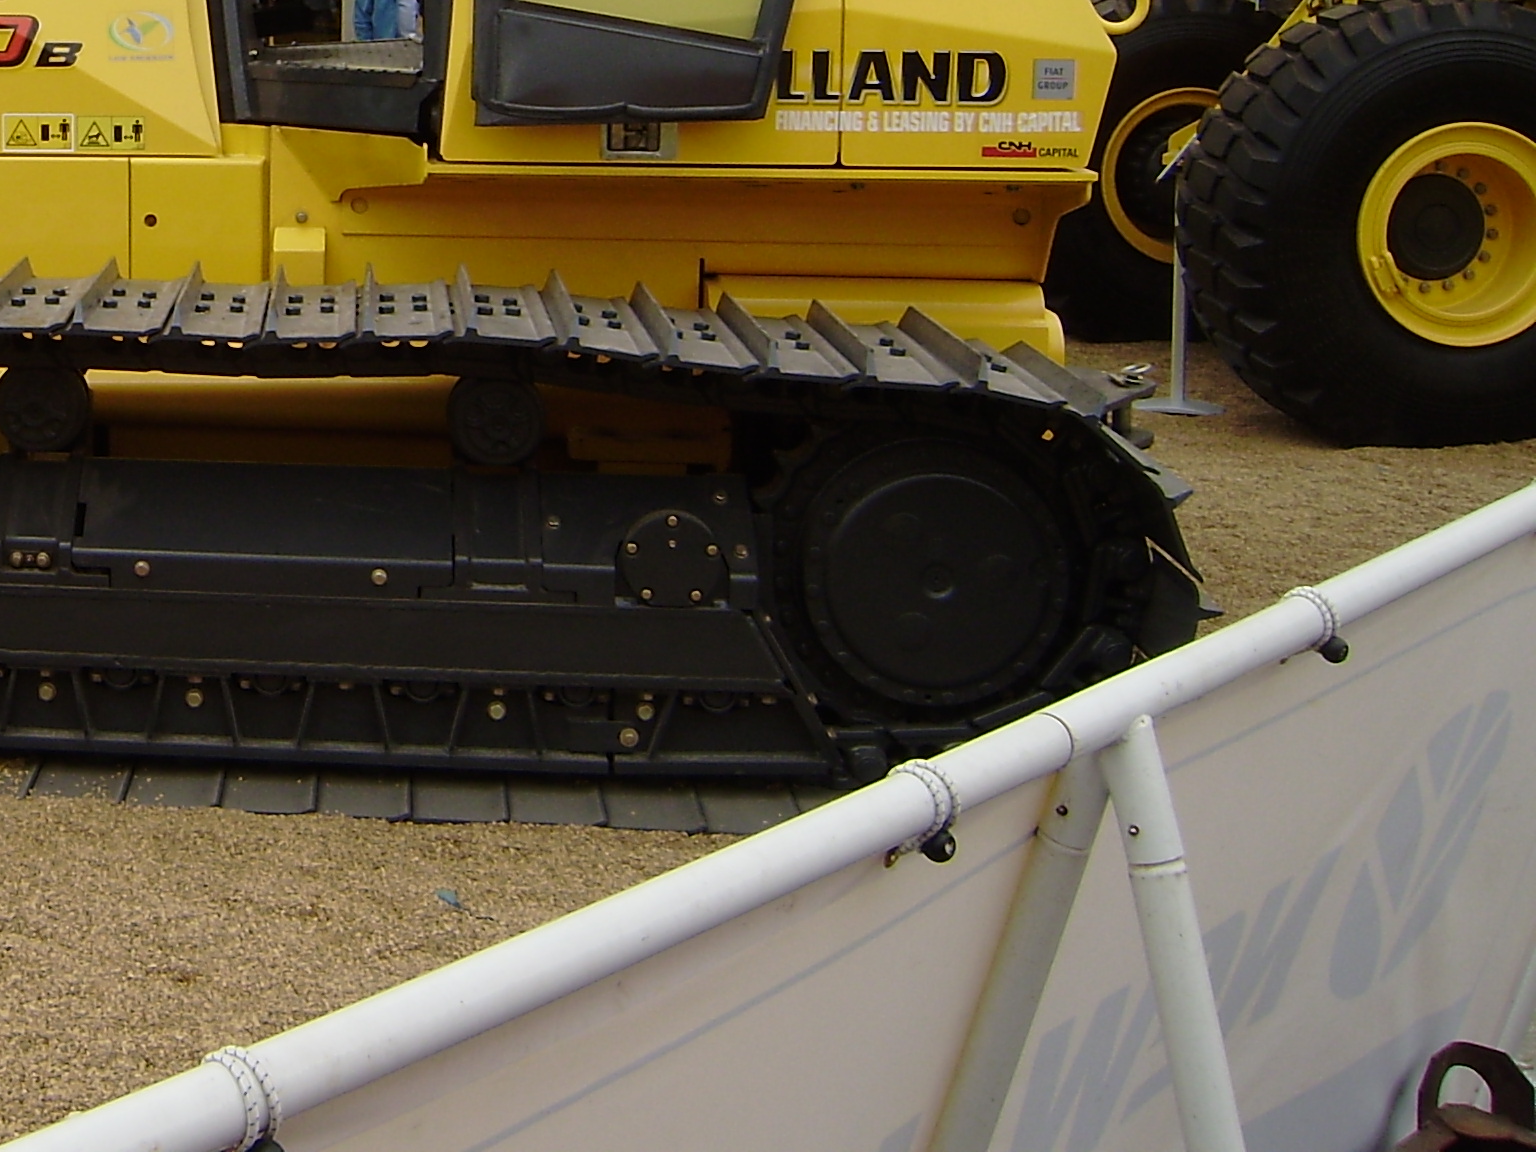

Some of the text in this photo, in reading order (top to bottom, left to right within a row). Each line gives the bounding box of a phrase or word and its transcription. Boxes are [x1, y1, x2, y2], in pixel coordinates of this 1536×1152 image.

[1044, 67, 1063, 76] FIAT
[1037, 81, 1069, 90] GROUP
[775, 110, 1082, 133] FINANCING & LEASING BY CNH CAPITAL
[997, 141, 1079, 159] CNH CAPITAL
